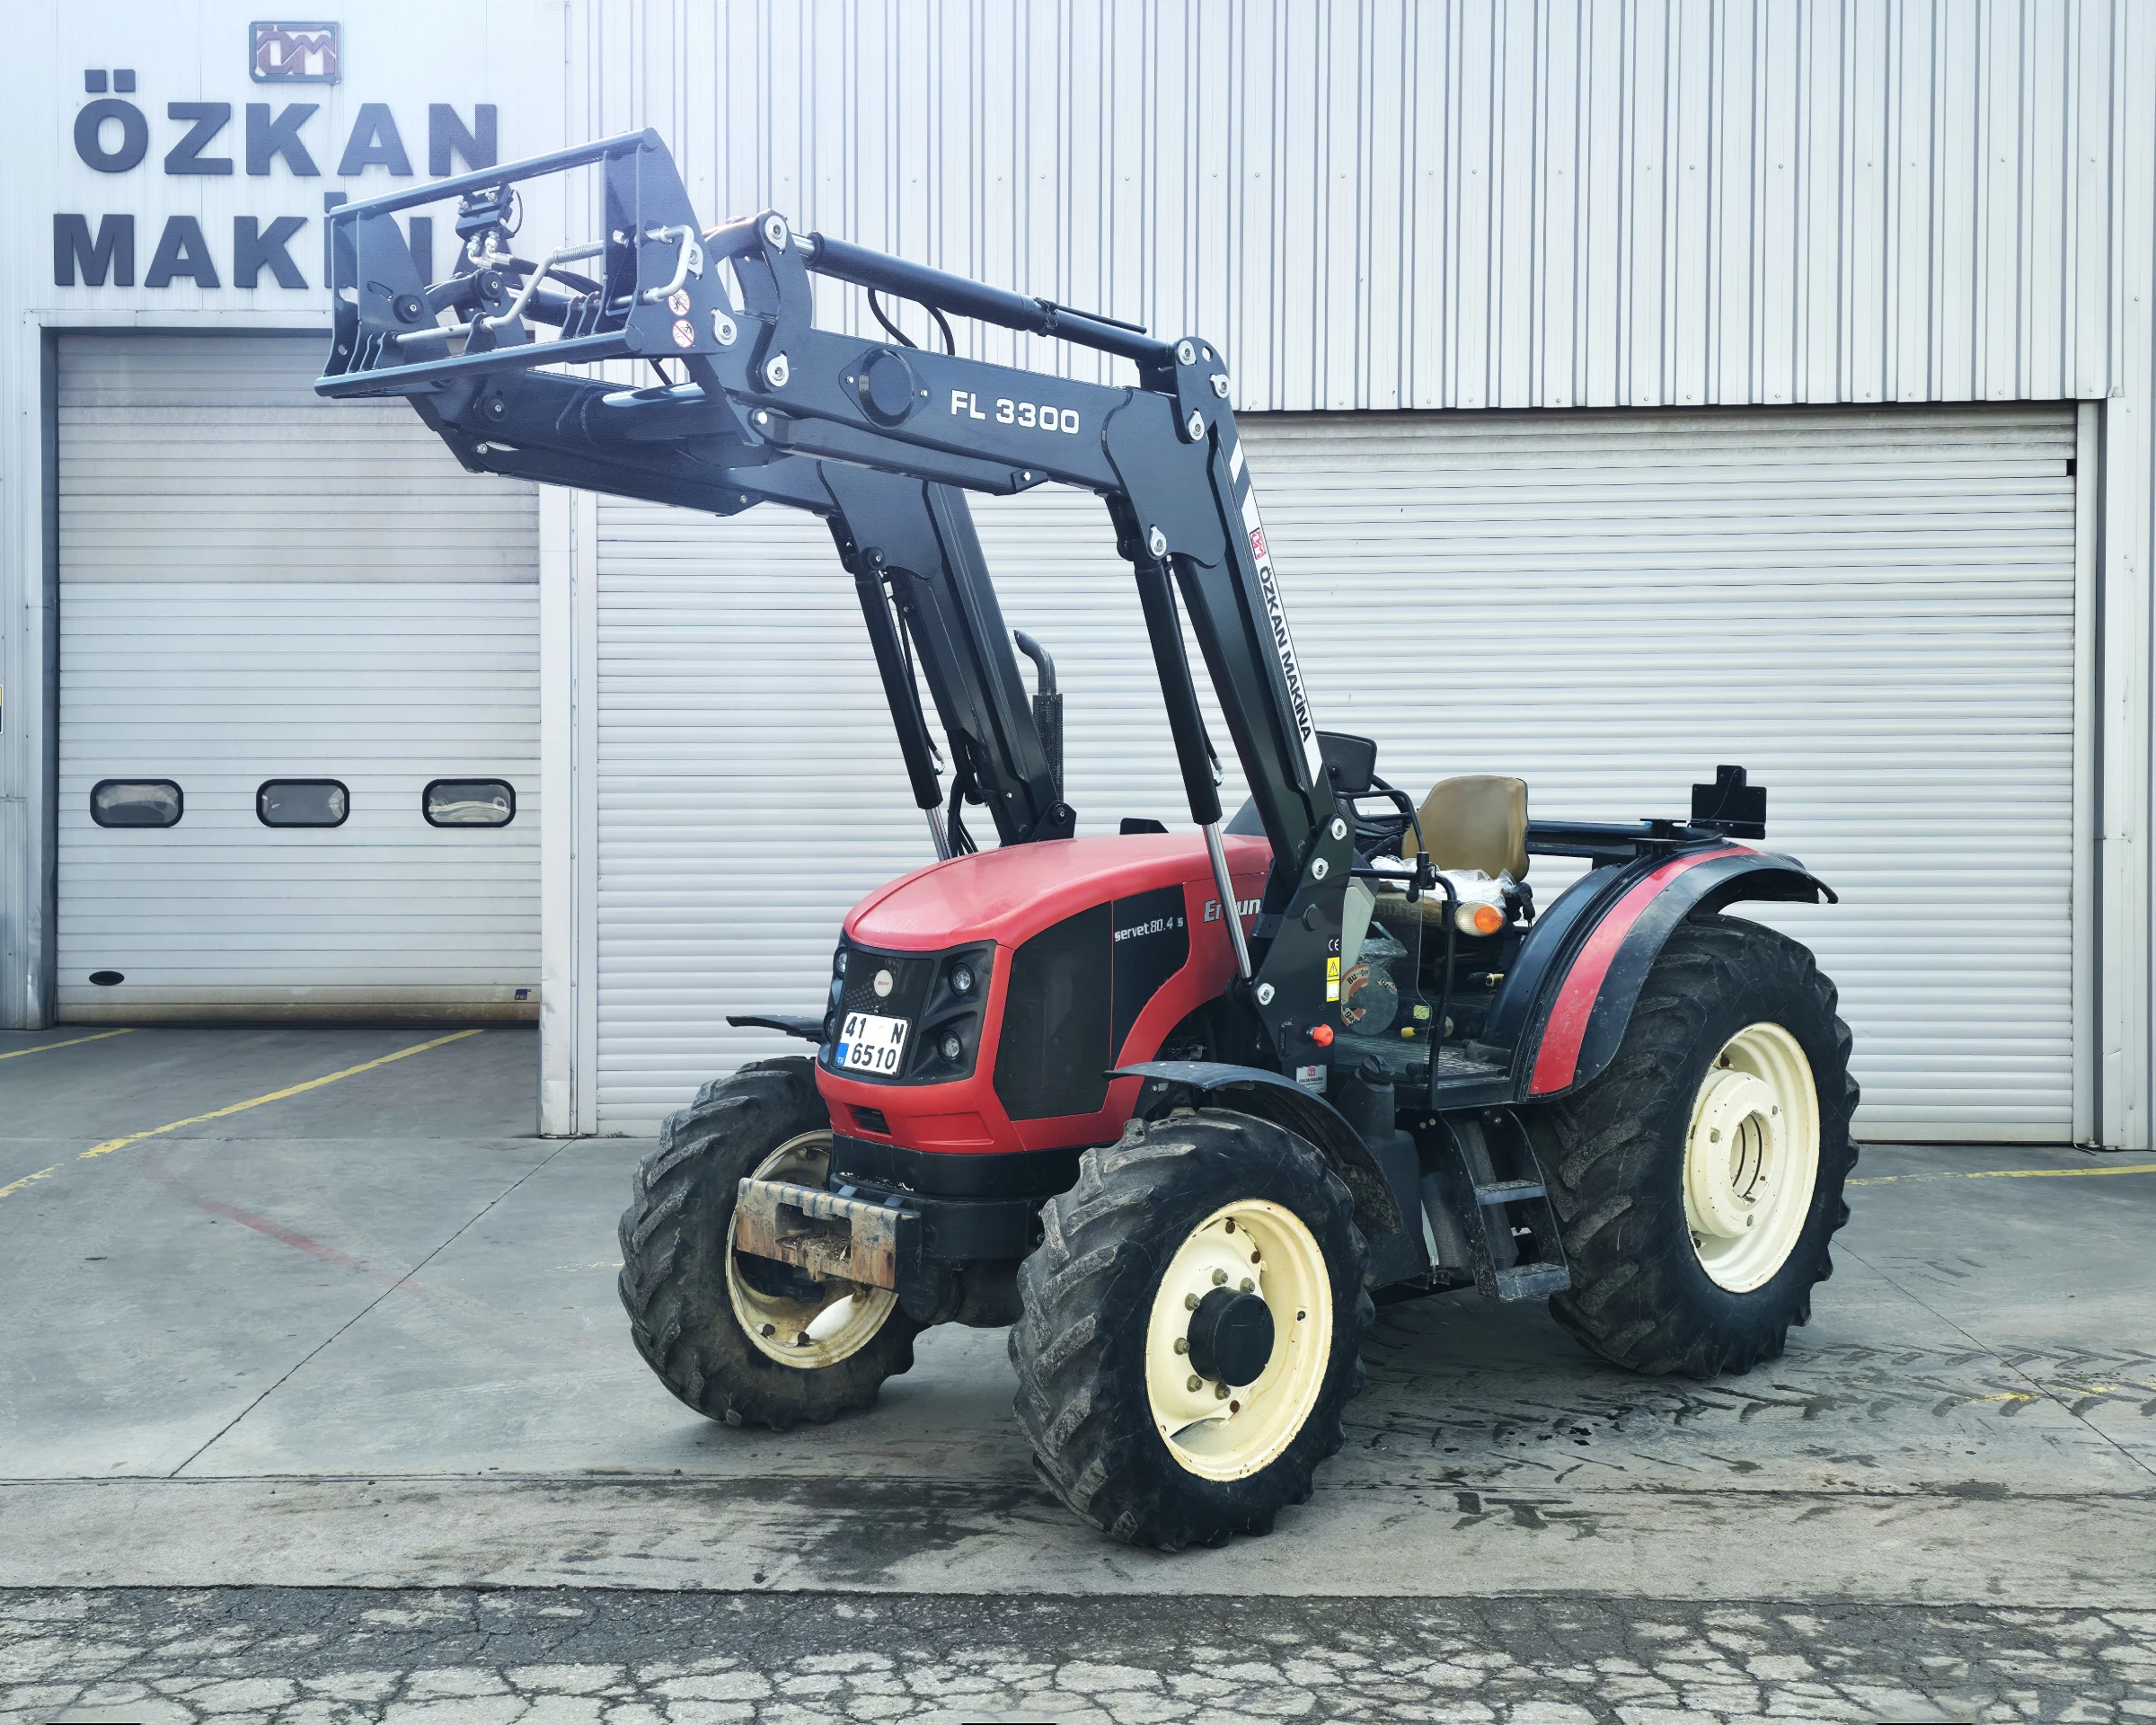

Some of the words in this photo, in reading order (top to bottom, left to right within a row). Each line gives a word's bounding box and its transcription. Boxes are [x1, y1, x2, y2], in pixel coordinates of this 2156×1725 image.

[74, 68, 499, 175] ÖZKAN
[950, 389, 986, 420] FL
[995, 398, 1080, 434] 3300
[1259, 565, 1288, 649] ÖZKAN
[1281, 650, 1312, 743] MAKİNA
[1203, 898, 1261, 923] Erun
[1114, 923, 1150, 942] servet
[1150, 916, 1173, 933] 80.4
[1328, 939, 1339, 951] CE
[845, 1015, 867, 1039] 41
[890, 1022, 904, 1044] N
[851, 1042, 897, 1069] 6510
